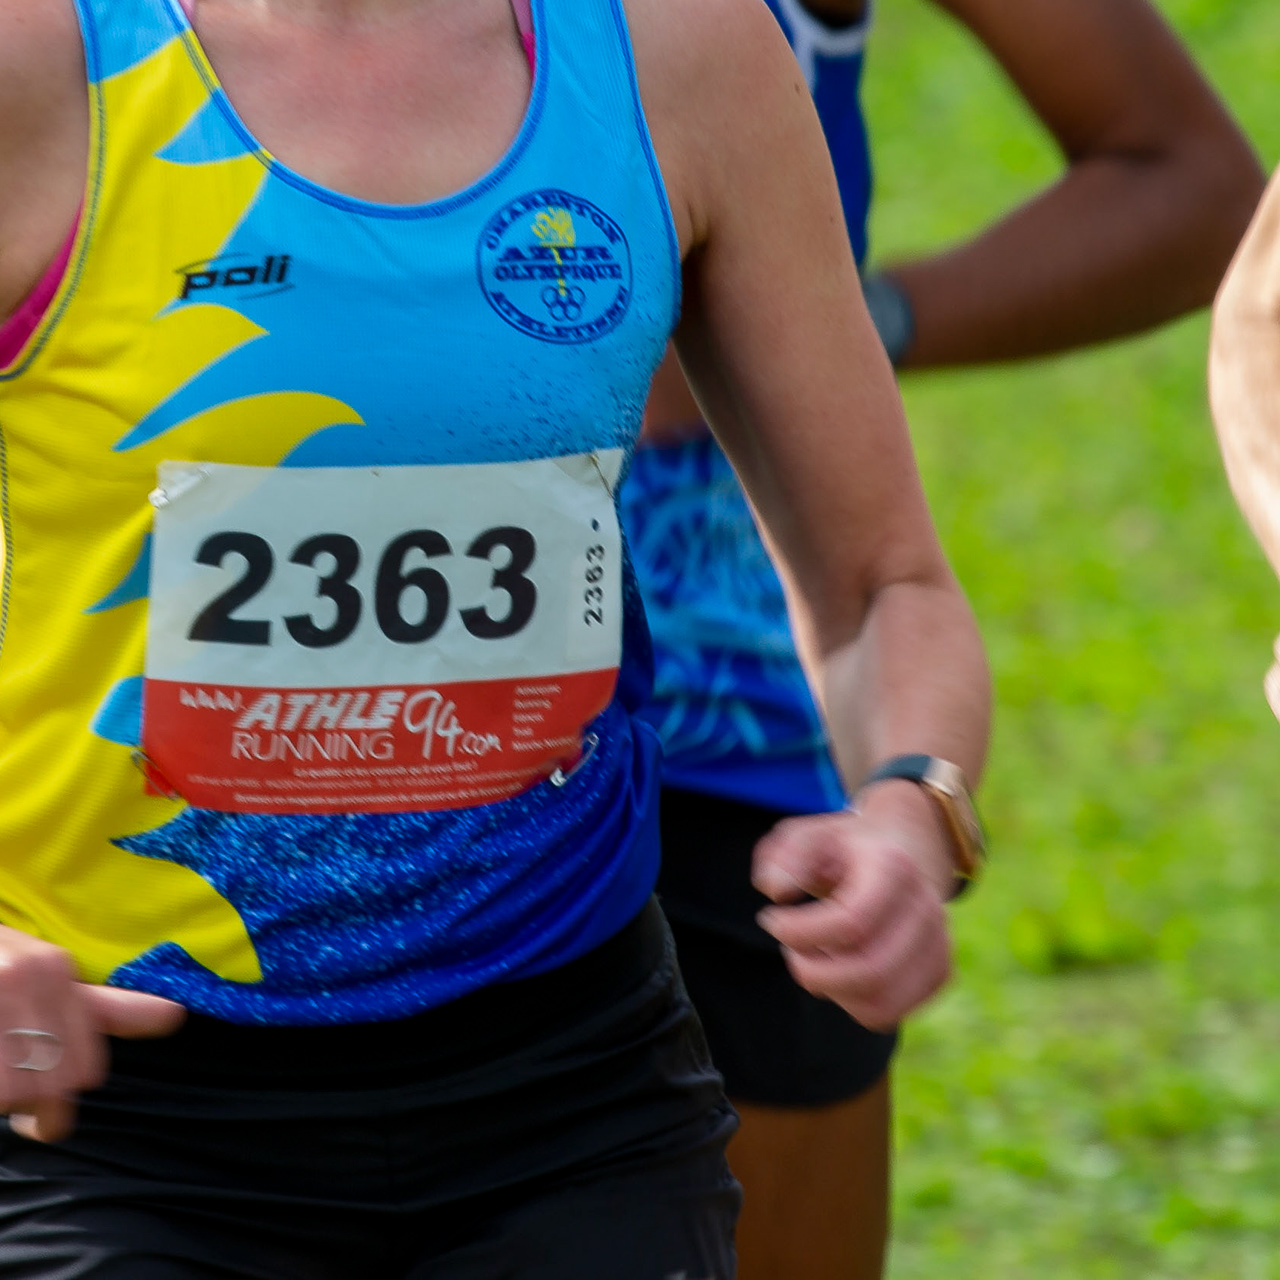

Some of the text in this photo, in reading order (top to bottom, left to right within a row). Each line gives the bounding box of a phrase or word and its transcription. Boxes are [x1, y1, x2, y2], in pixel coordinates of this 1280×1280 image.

[494, 263, 623, 282] OLYMPIQUE
[498, 245, 614, 262] AZUR
[179, 254, 290, 300] poli
[187, 524, 539, 650] 2363
[584, 544, 606, 627] 2363
[230, 730, 396, 762] RUNNING
